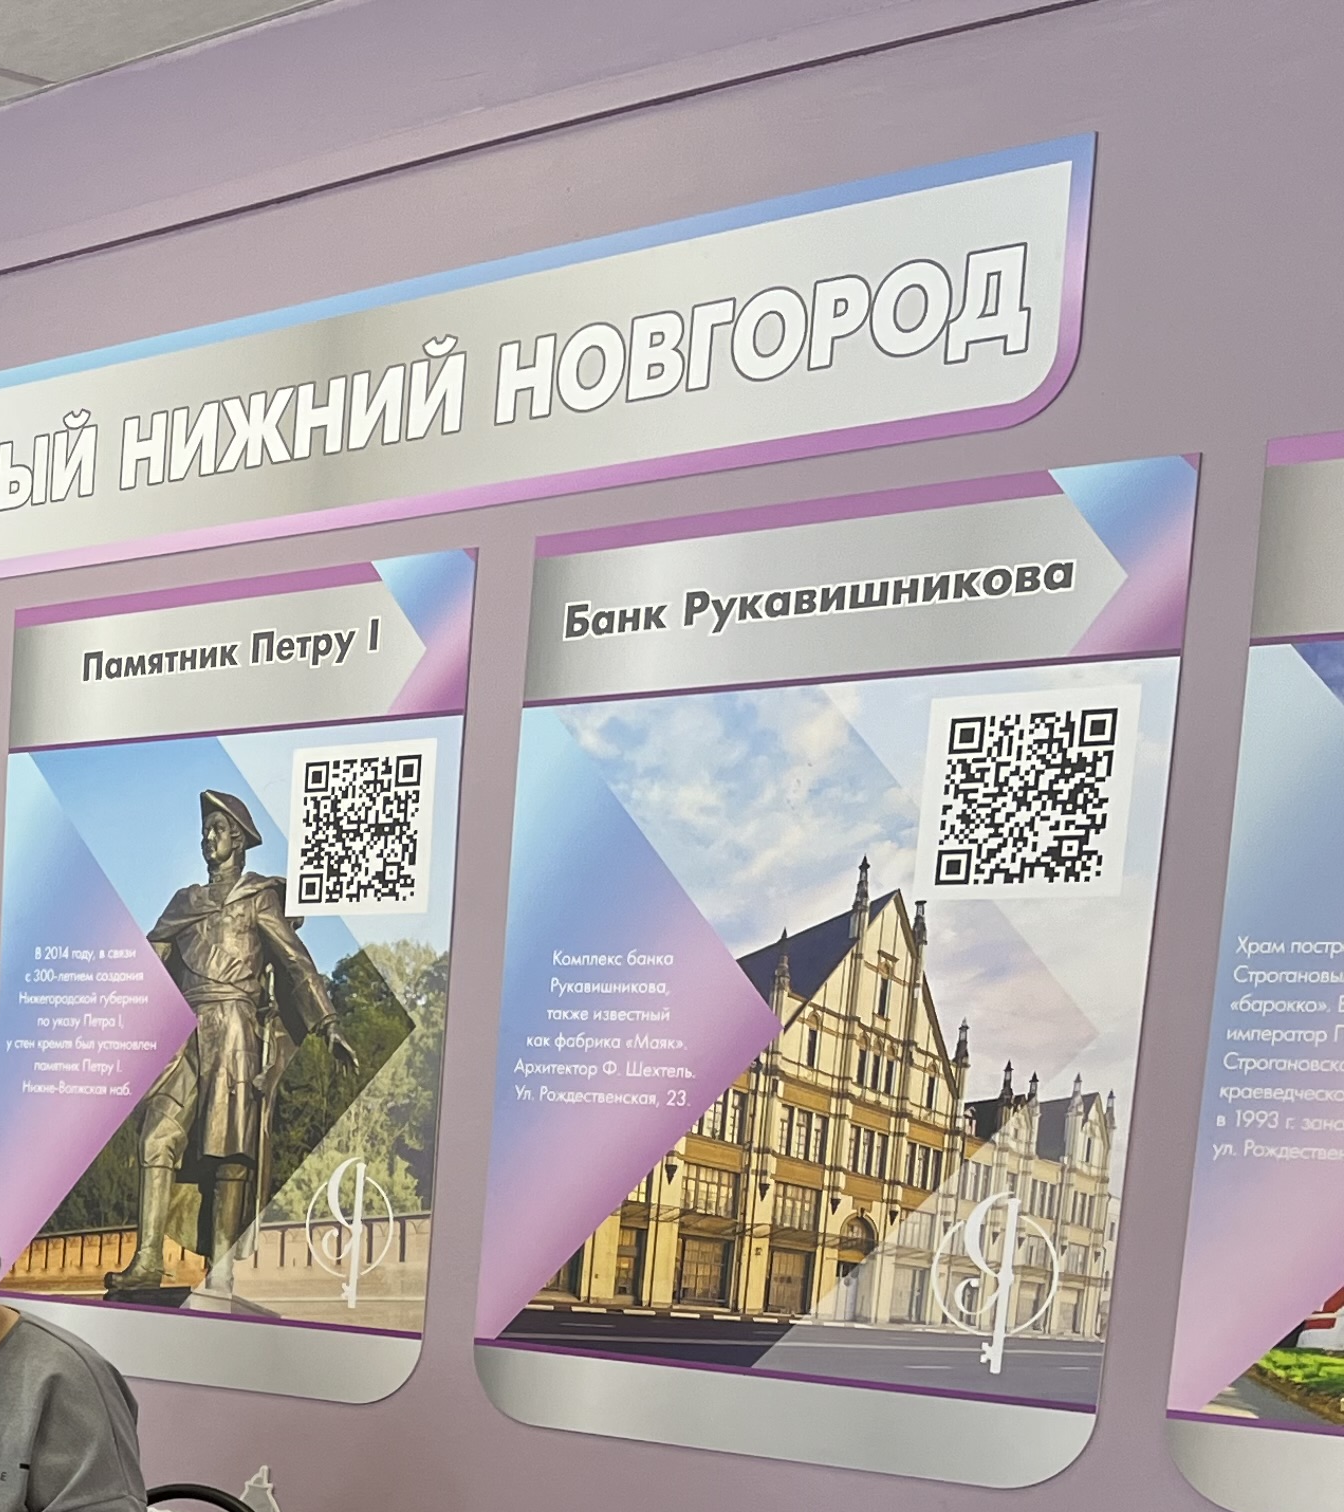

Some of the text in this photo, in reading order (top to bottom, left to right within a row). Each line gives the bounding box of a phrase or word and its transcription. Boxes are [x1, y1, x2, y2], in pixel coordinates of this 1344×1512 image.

[118, 336, 466, 489] НИЖНИЙ
[494, 244, 1033, 426] НОВГОРОД
[563, 560, 1076, 640] Банк Рукавишникова
[82, 619, 380, 684] Памятник Петру I
[35, 947, 41, 960] В
[44, 946, 69, 960] 2014
[108, 948, 136, 959] связи
[1236, 936, 1344, 958] Храм постр
[552, 949, 674, 966] Комплекс банка
[25, 968, 144, 983] с 300-летием создания
[550, 977, 670, 997] Рукавишникова,
[19, 990, 149, 1008] Нижегородской губернии
[1230, 993, 1331, 1016] «барокко».
[37, 1017, 50, 1027] по
[52, 1017, 81, 1030] указу
[83, 1013, 115, 1030] Петра
[547, 1007, 670, 1022] также известный
[6, 1035, 157, 1053] у стен кремля был установлен
[527, 1032, 688, 1052] как фабрика «Маяк».
[1227, 1027, 1328, 1047] император
[34, 1061, 79, 1072] памятник
[82, 1058, 114, 1076] Петру
[514, 1058, 598, 1079] Архитектор
[625, 1061, 696, 1079] Шехтель.
[515, 1084, 534, 1101] Ул.
[539, 1085, 660, 1108] Рождественская,
[1216, 1115, 1226, 1127] в
[1235, 1109, 1279, 1129] 1993
[1213, 1144, 1236, 1161] ул.
